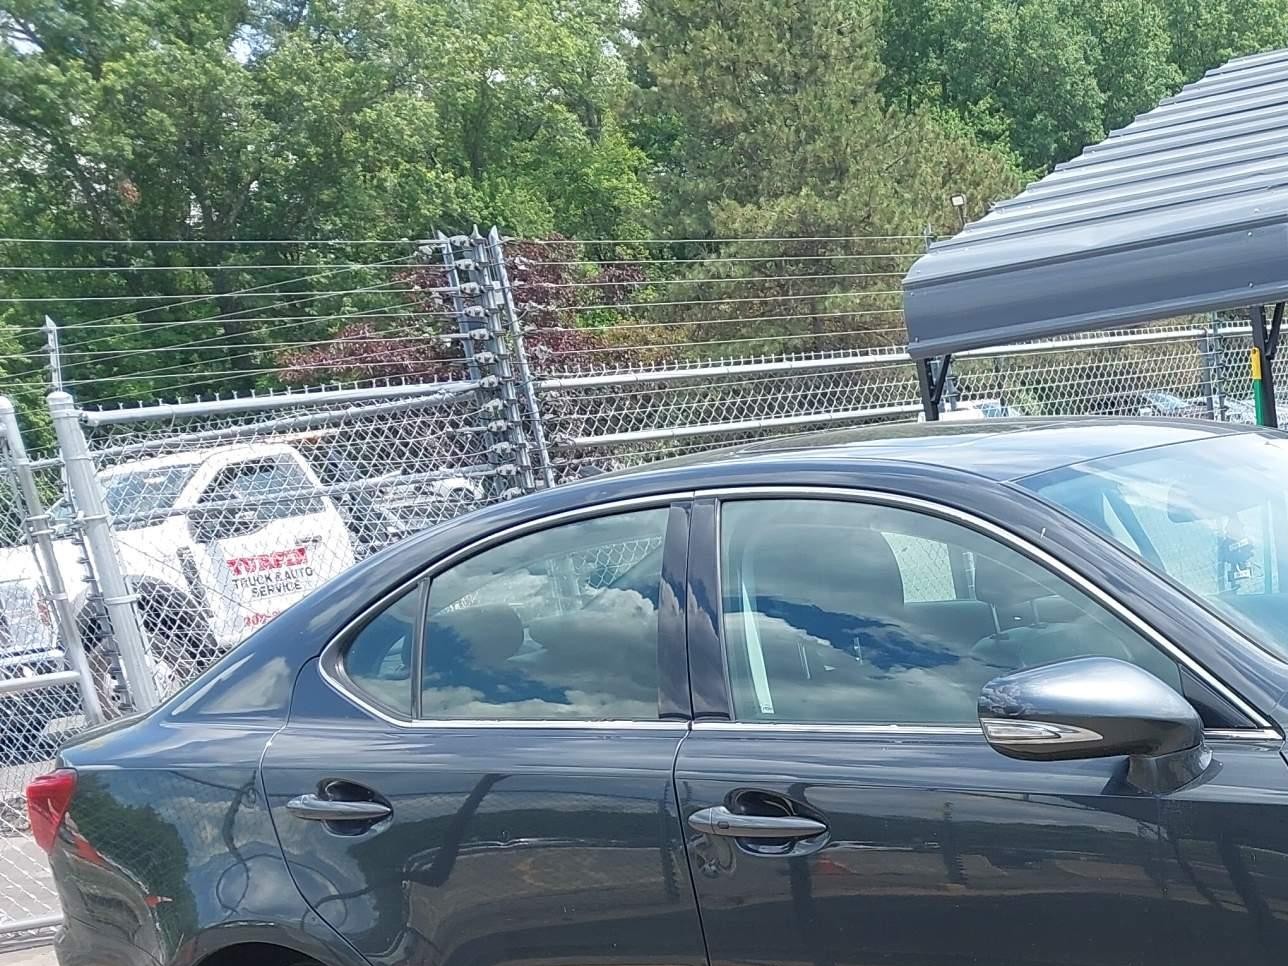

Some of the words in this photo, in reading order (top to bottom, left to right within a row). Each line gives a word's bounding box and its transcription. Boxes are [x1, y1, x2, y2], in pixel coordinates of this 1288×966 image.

[232, 574, 273, 589] TRUCK
[275, 572, 282, 582] &
[284, 566, 313, 580] AUTO
[251, 581, 302, 598] SERVICE
